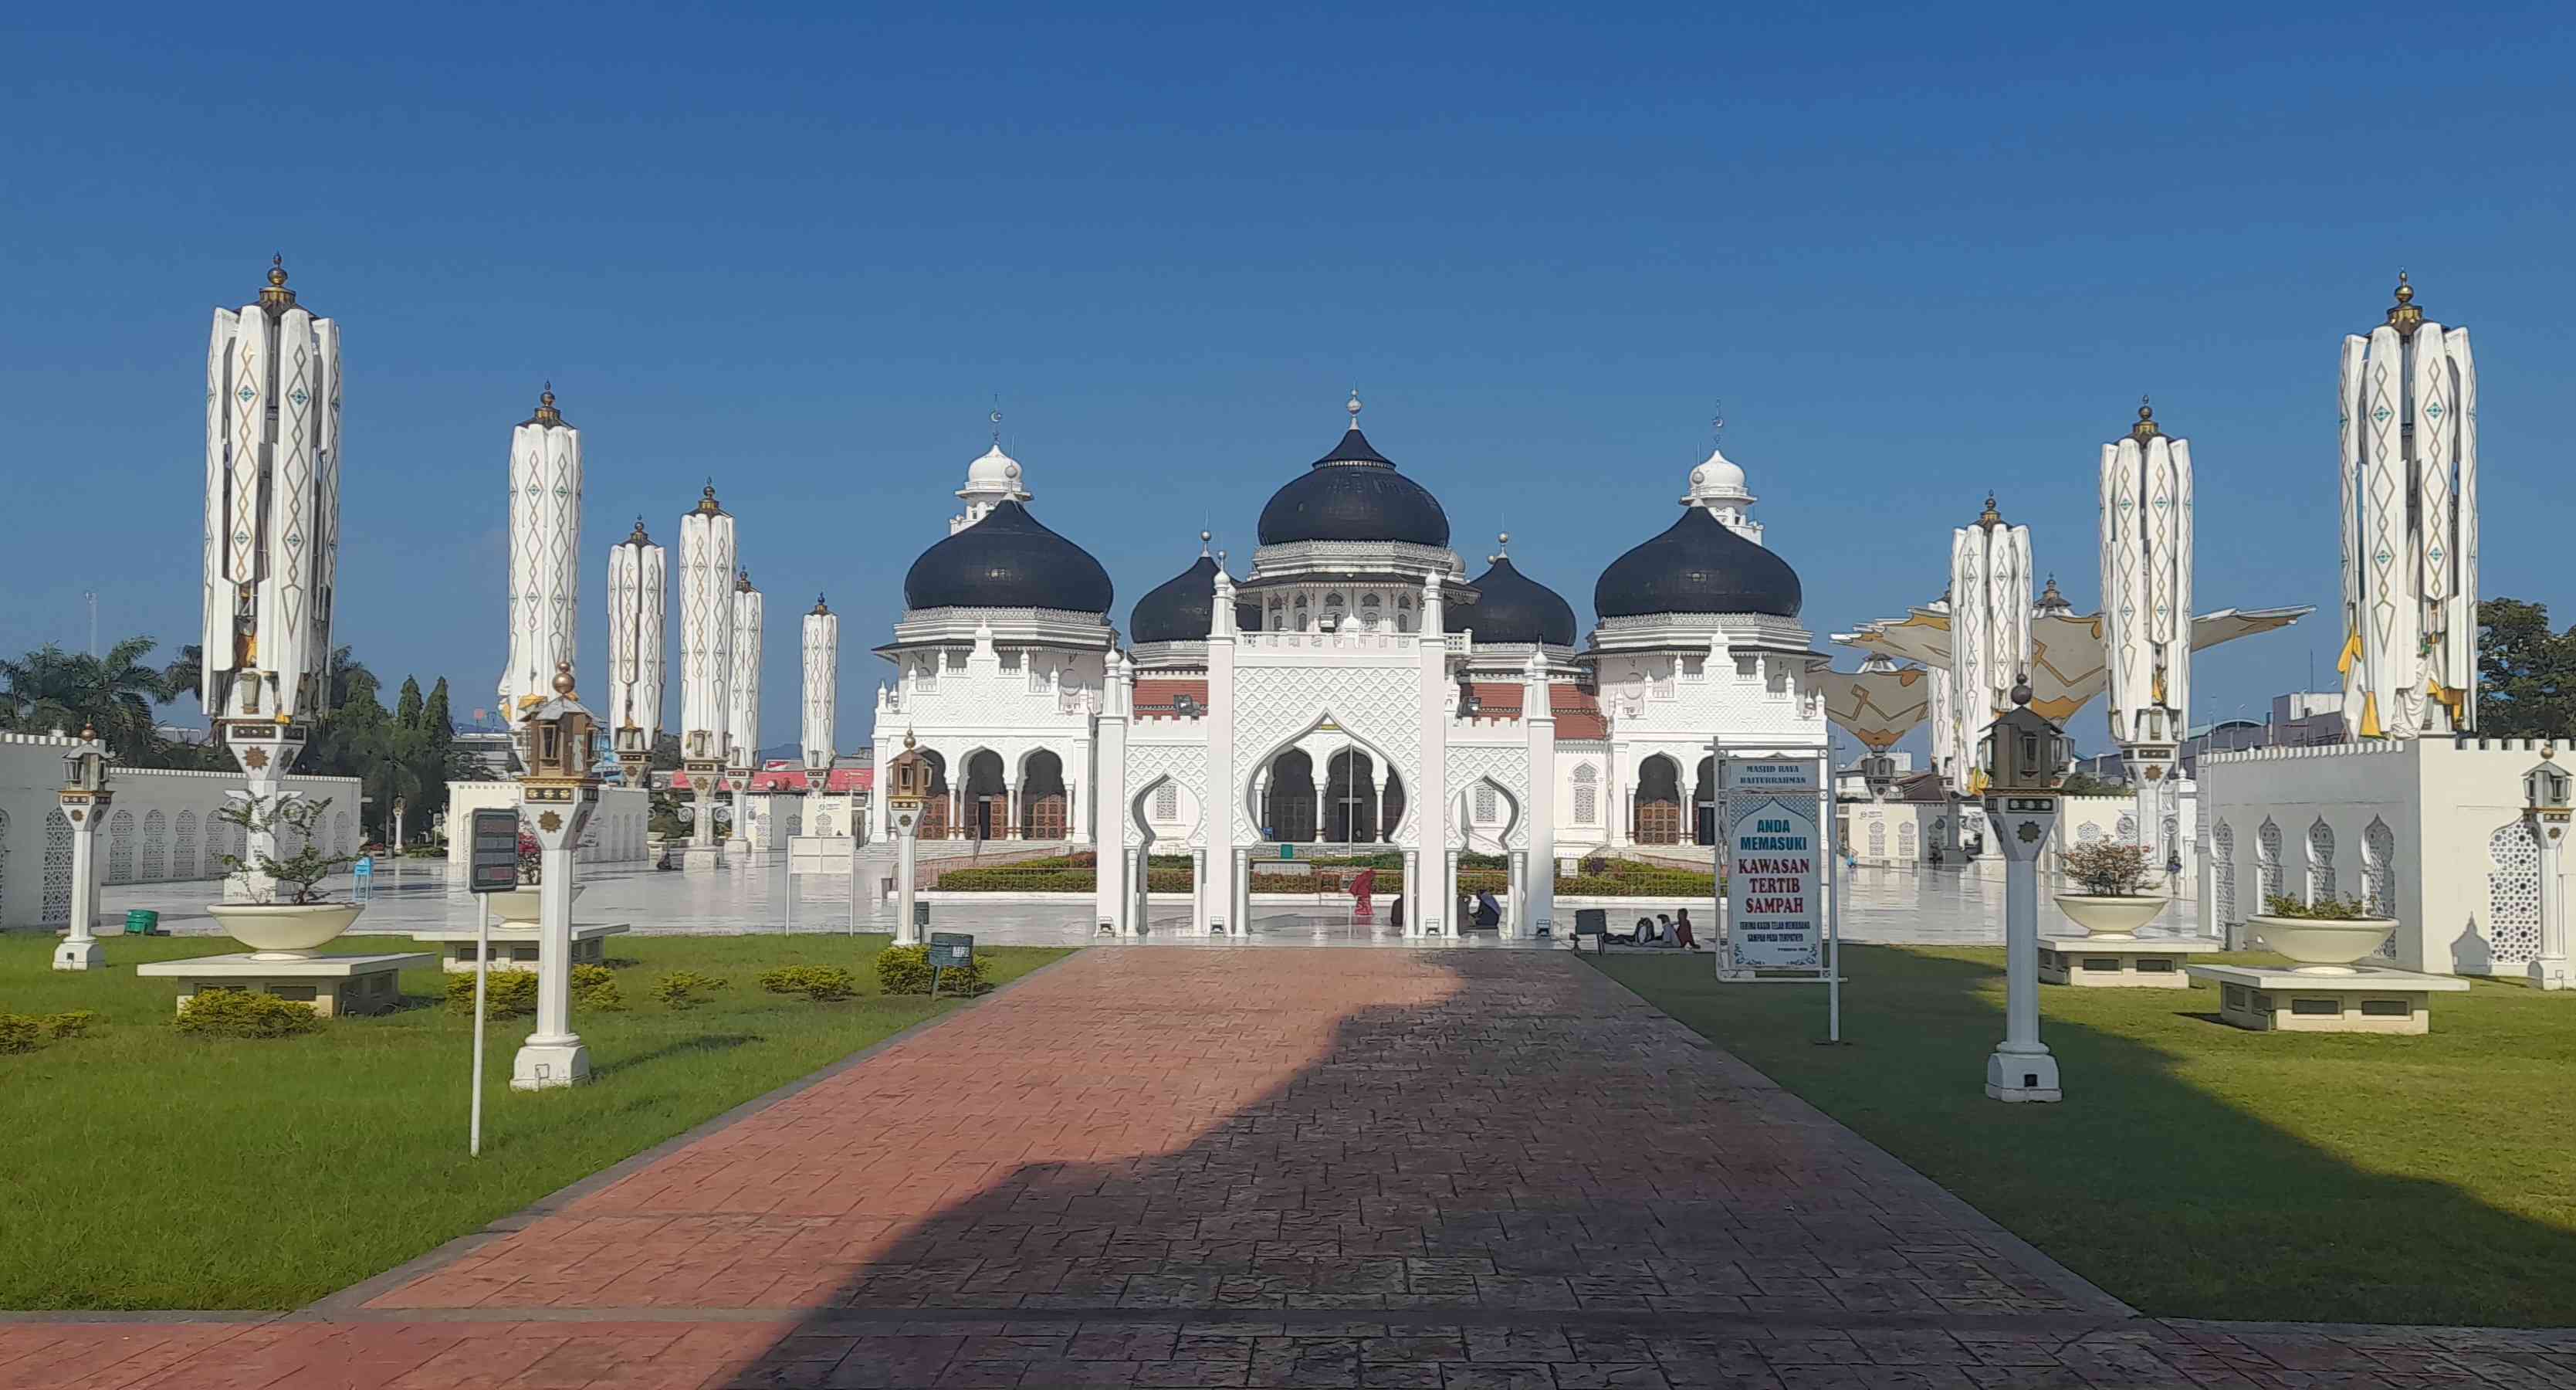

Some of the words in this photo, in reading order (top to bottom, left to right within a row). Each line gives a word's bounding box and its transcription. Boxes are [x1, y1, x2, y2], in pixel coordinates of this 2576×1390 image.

[1757, 819, 1791, 833] ANDA
[1740, 836, 1808, 851] MEMASUKI
[1738, 858, 1810, 874] KAWASAN
[1749, 878, 1801, 893] TERTIB
[1745, 897, 1804, 914] SAMPAH
